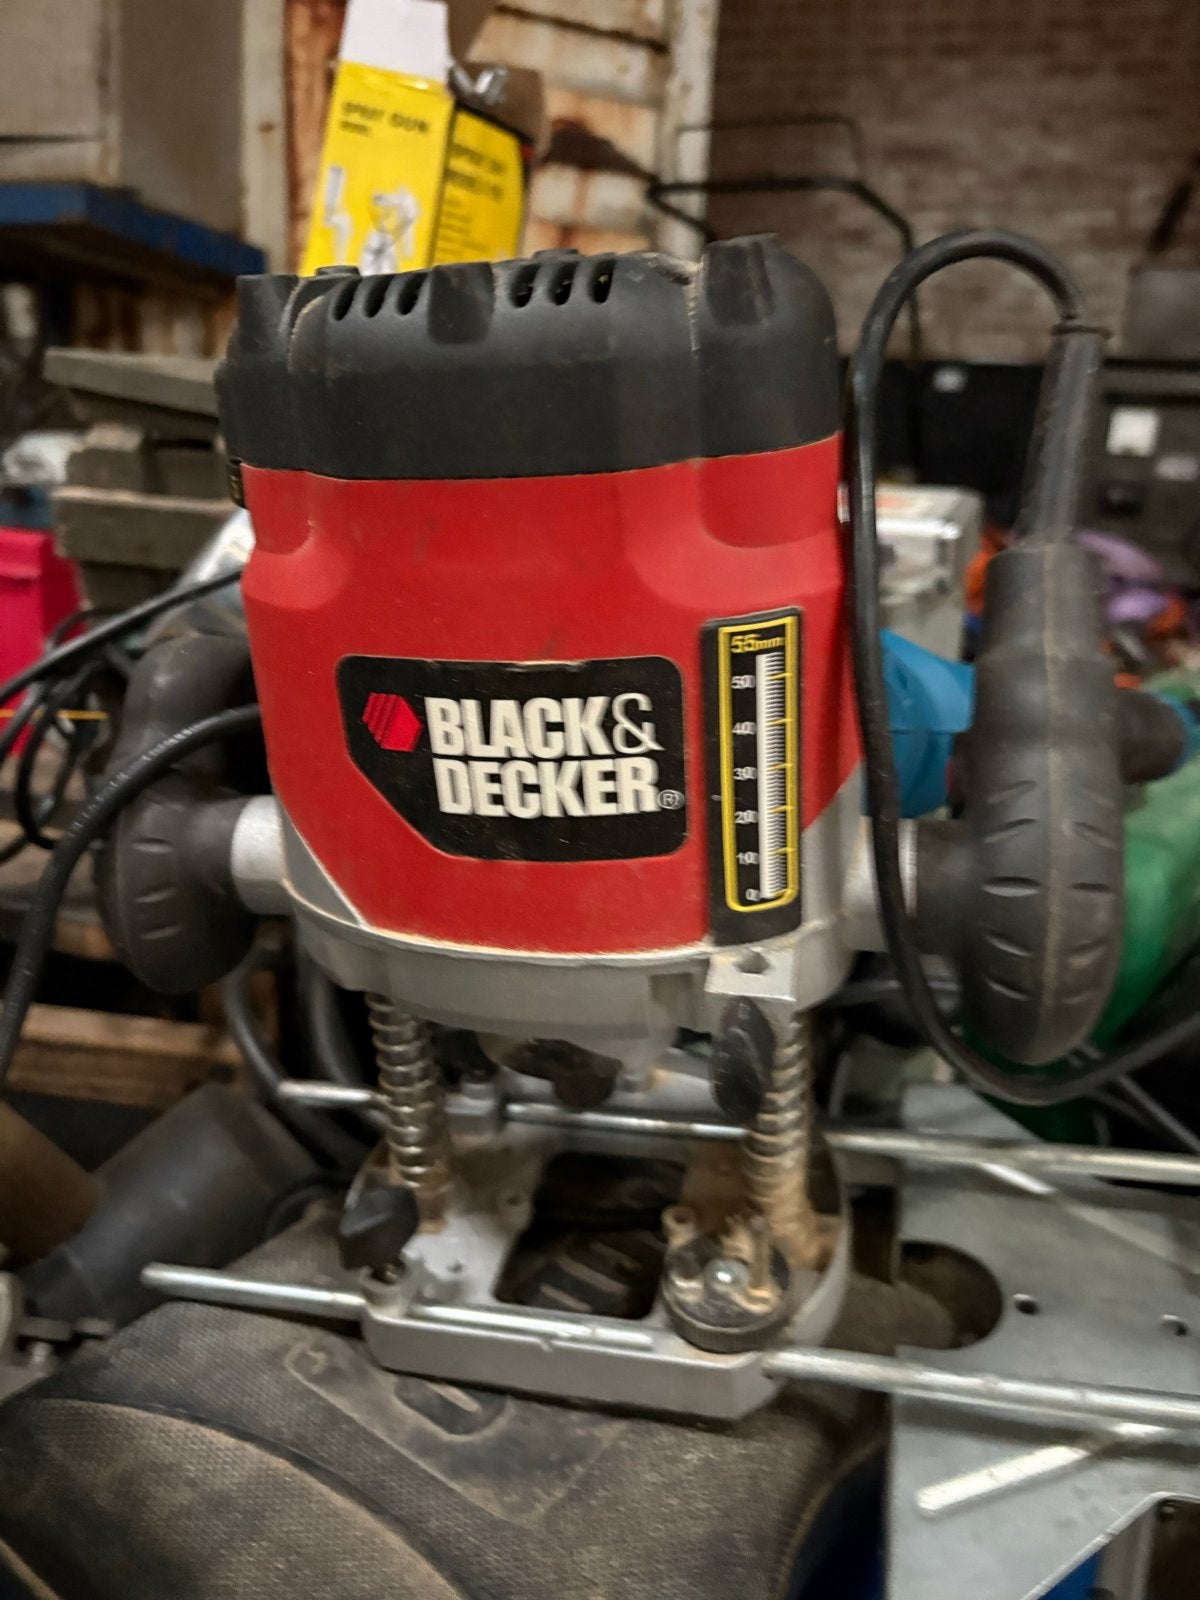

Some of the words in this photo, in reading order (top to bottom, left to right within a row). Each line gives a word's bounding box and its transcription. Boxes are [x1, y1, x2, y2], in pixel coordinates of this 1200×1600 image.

[730, 633, 785, 653] 55mm
[731, 674, 756, 690] 50
[732, 721, 757, 735] 40
[733, 766, 758, 780] 30
[432, 756, 662, 819] DECKER
[734, 810, 759, 824] 20
[736, 851, 760, 865] 10
[745, 888, 761, 901] 0
